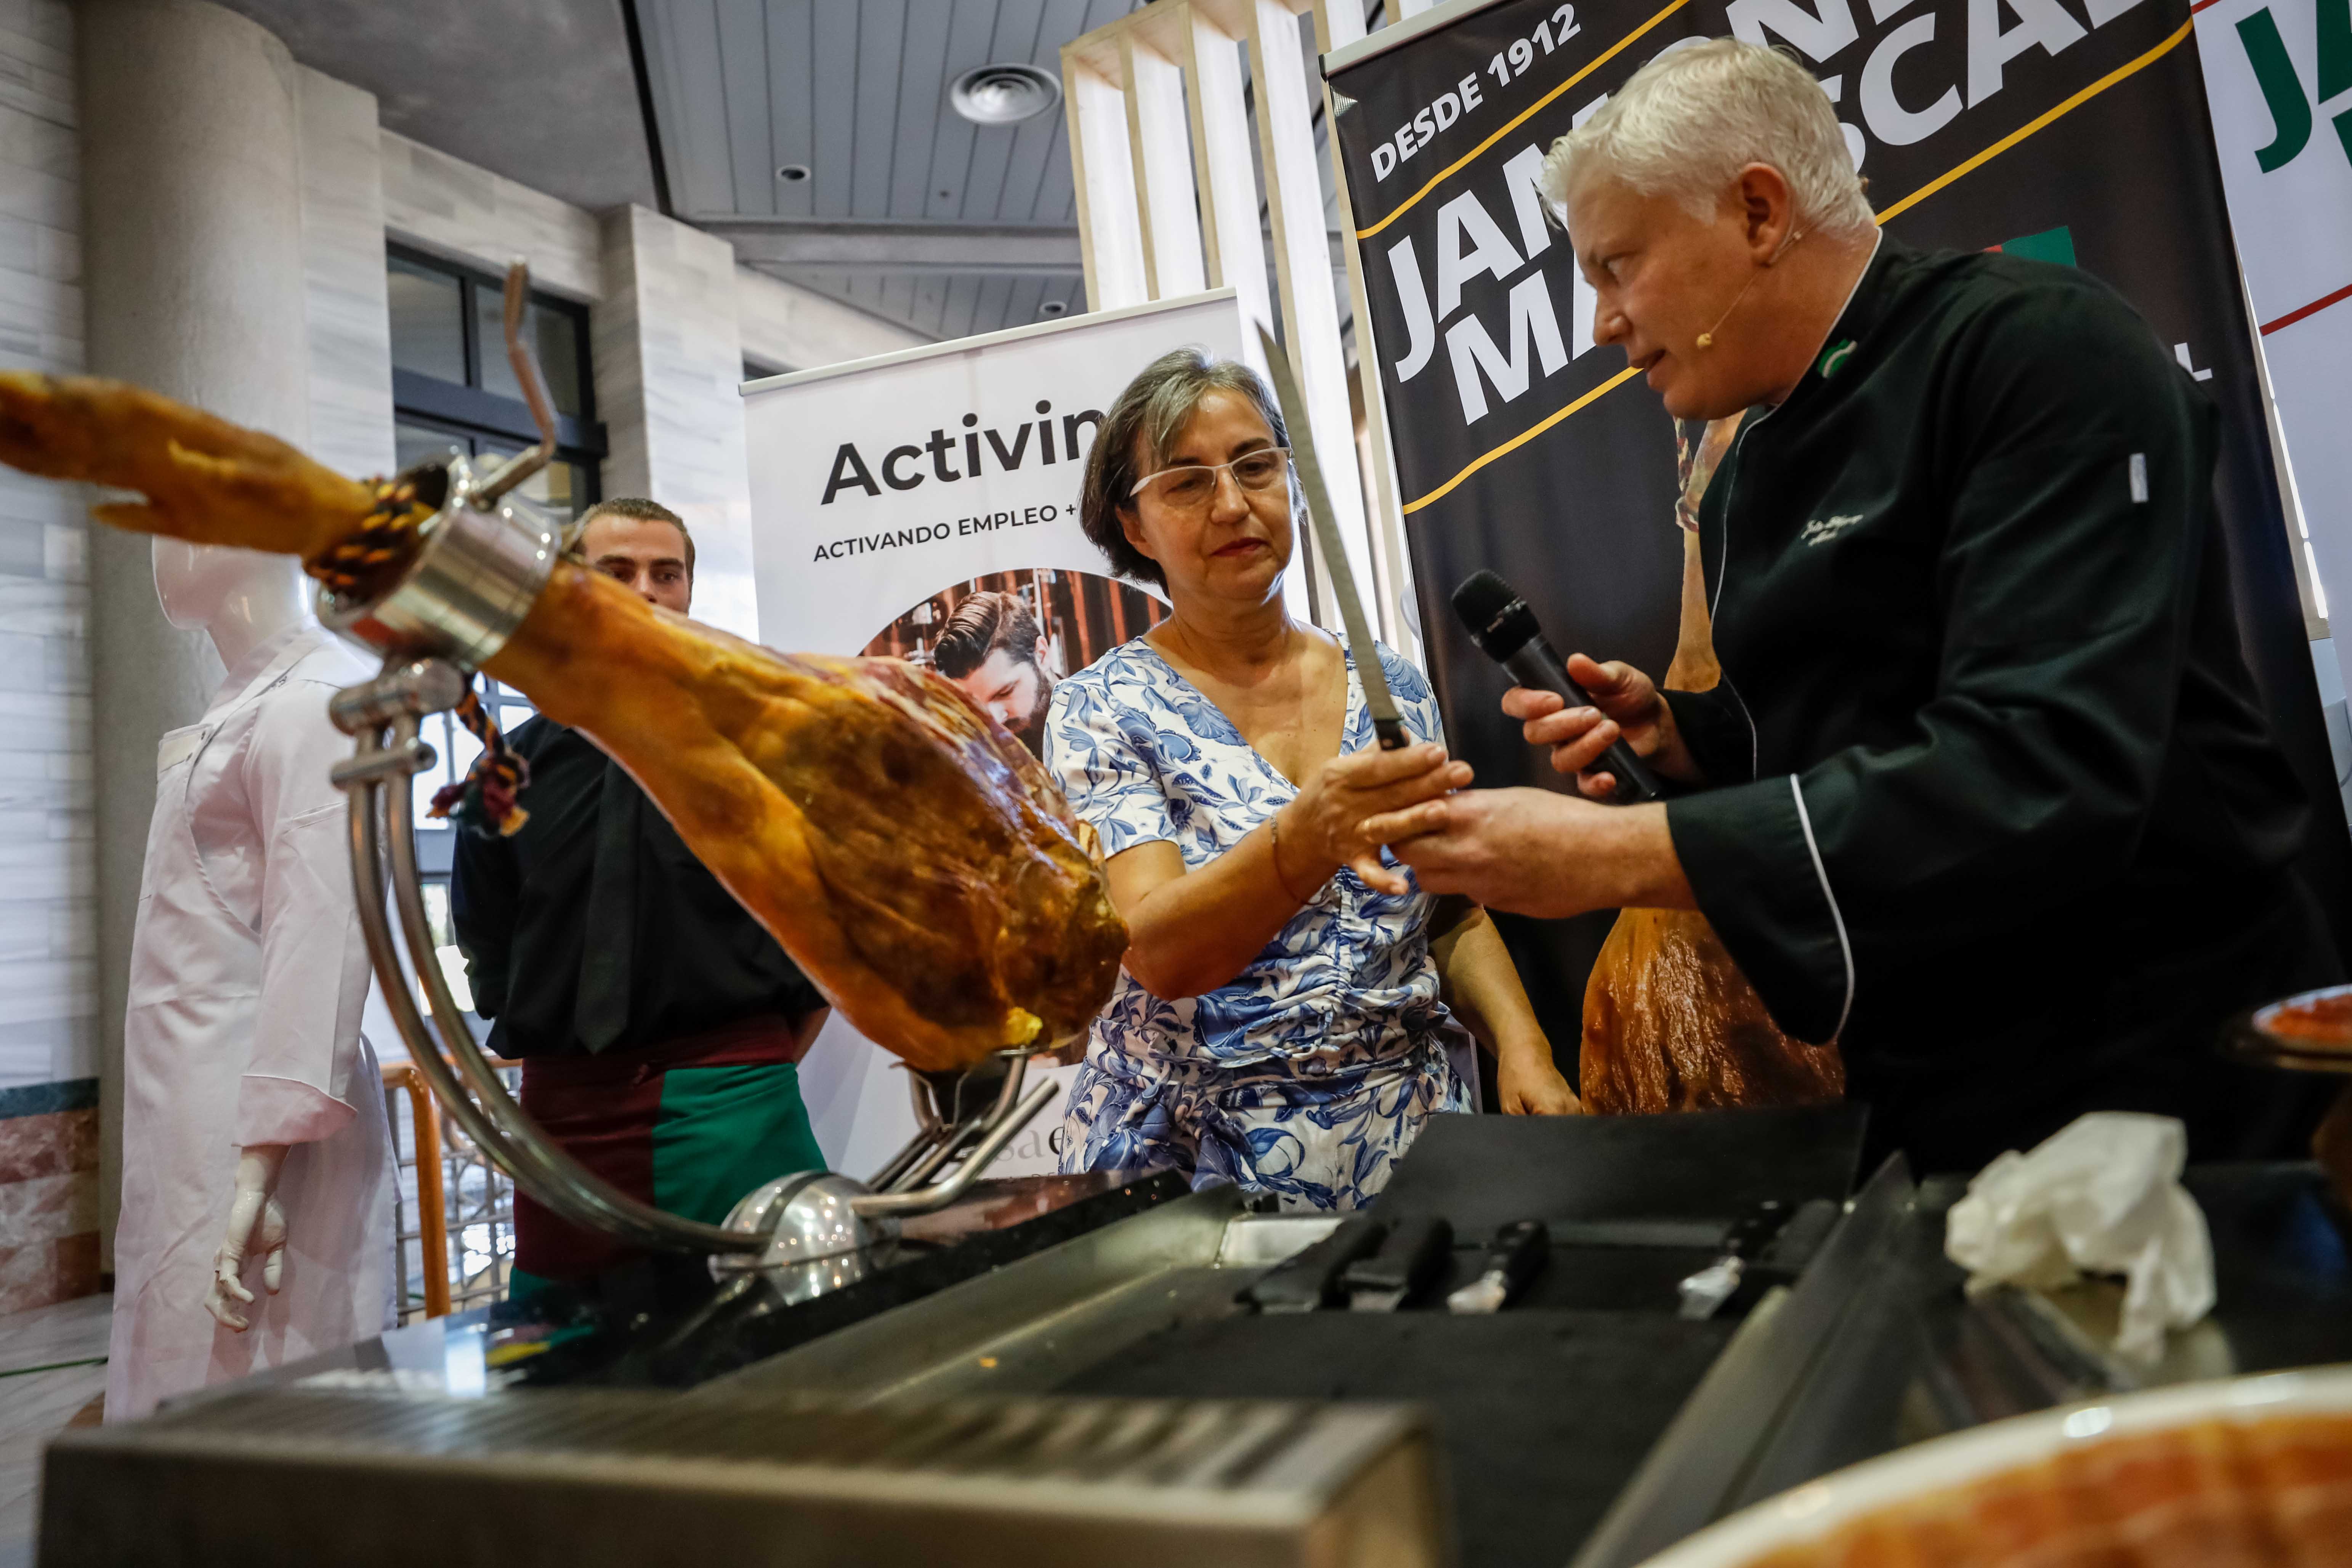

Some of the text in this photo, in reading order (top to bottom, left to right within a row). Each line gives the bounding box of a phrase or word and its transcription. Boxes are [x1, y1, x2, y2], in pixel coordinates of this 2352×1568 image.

[1370, 3, 1581, 183] DESDE 1912
[813, 523, 950, 562] ACTIVANDO
[958, 505, 1057, 536] EMPLEO
